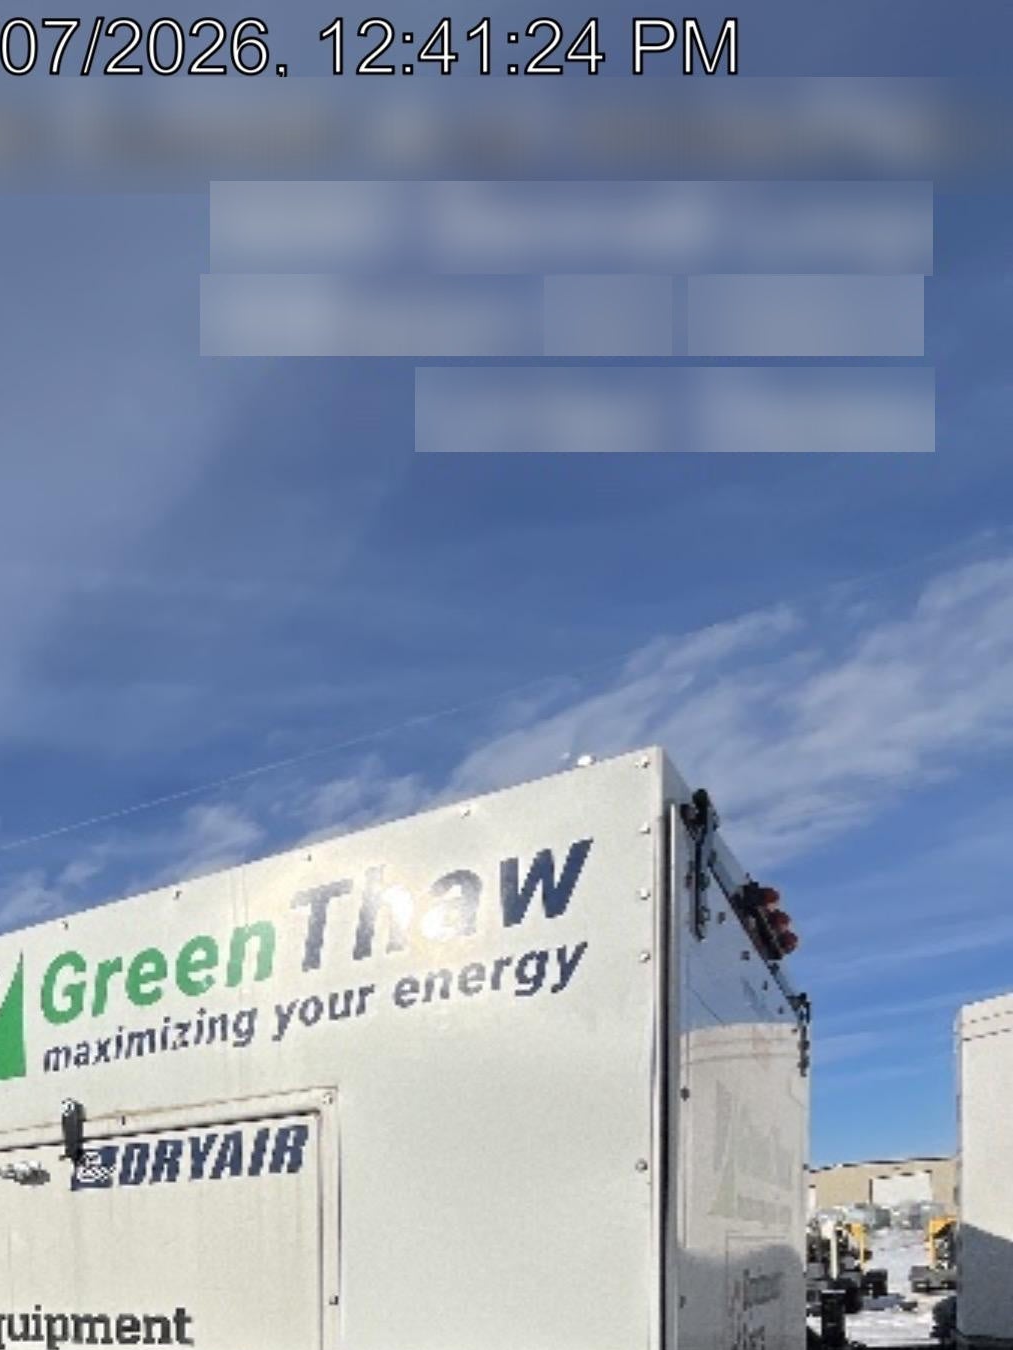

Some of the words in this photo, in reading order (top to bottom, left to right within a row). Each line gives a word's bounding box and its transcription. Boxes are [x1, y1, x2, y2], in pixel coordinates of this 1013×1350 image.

[43, 1007, 258, 1073] maximizing
[271, 983, 375, 1041] your
[392, 941, 588, 1008] energy
[119, 1124, 309, 1186] DRYAIR
